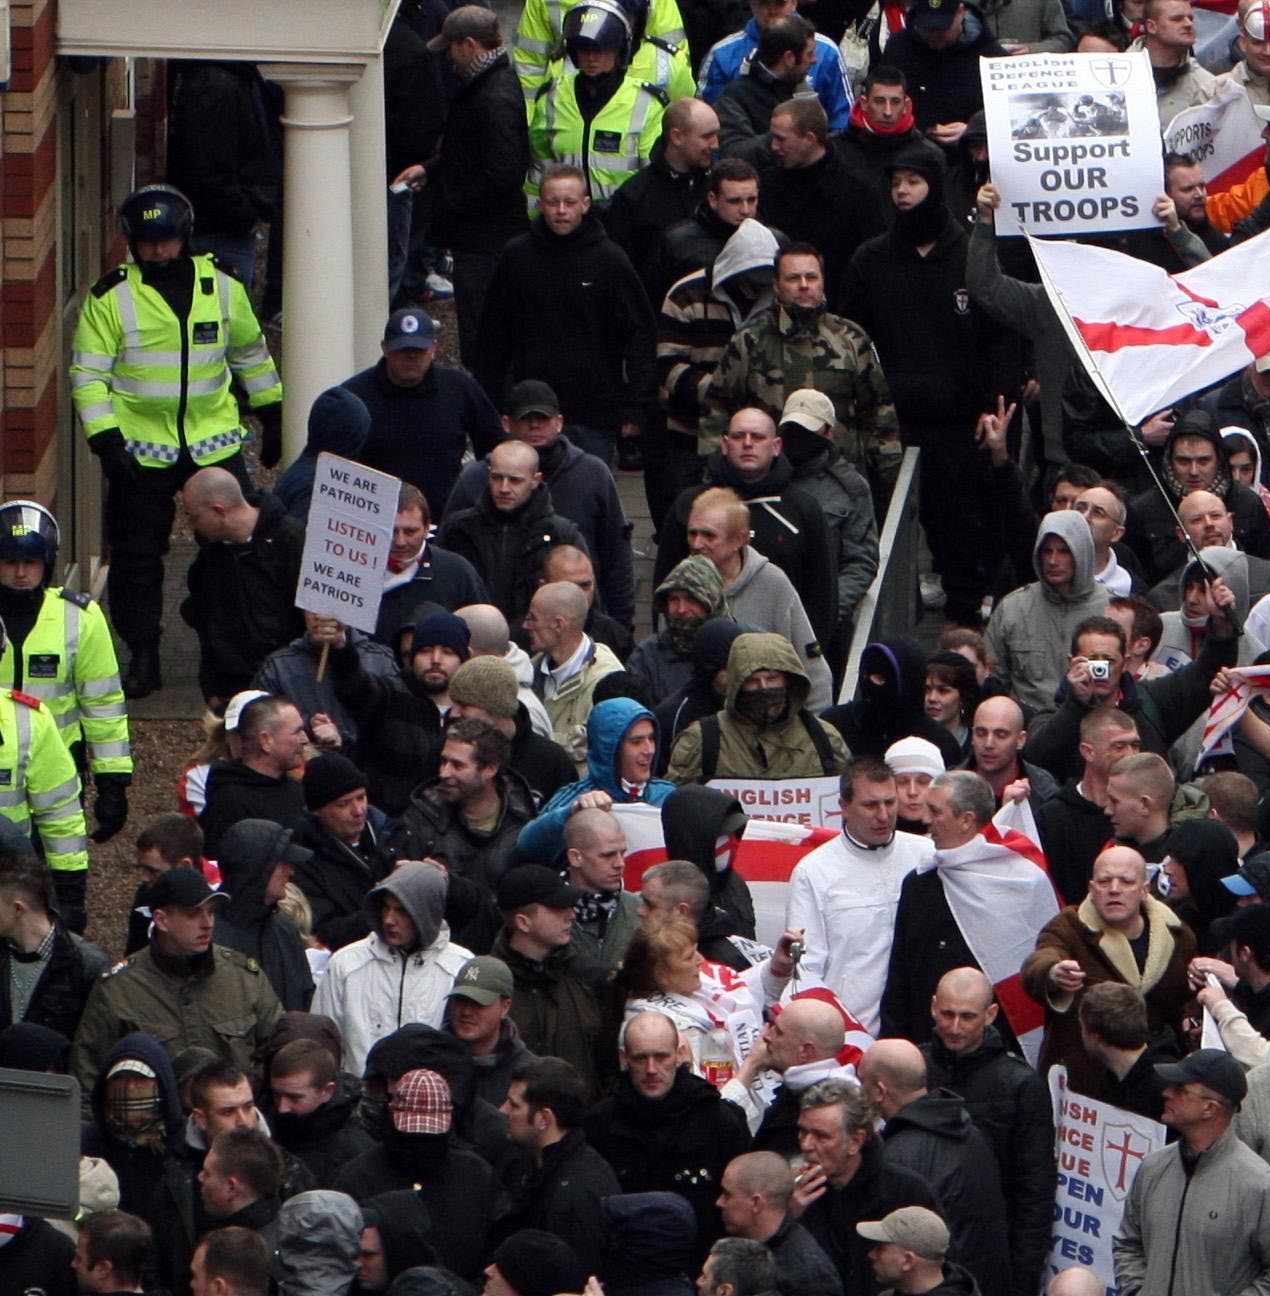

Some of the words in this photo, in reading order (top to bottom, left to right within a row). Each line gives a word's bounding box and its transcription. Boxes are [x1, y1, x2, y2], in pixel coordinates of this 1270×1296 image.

[989, 58, 1075, 71] ENGLISH
[990, 70, 1077, 81] DEFENCE
[991, 81, 1079, 92] LEAGUE
[1013, 138, 1130, 166] Support
[1040, 167, 1108, 192] OUR
[143, 208, 161, 220] MP
[1011, 195, 1140, 224] TROOPS
[329, 468, 350, 484] WE
[353, 477, 378, 494] ARE
[319, 484, 380, 514] PATRIOTS
[327, 518, 376, 546] LISTEN
[324, 538, 344, 556] TO
[348, 548, 368, 566] US
[313, 561, 333, 578] WE
[336, 570, 362, 588] ARE
[303, 577, 365, 608] PATRIOTS
